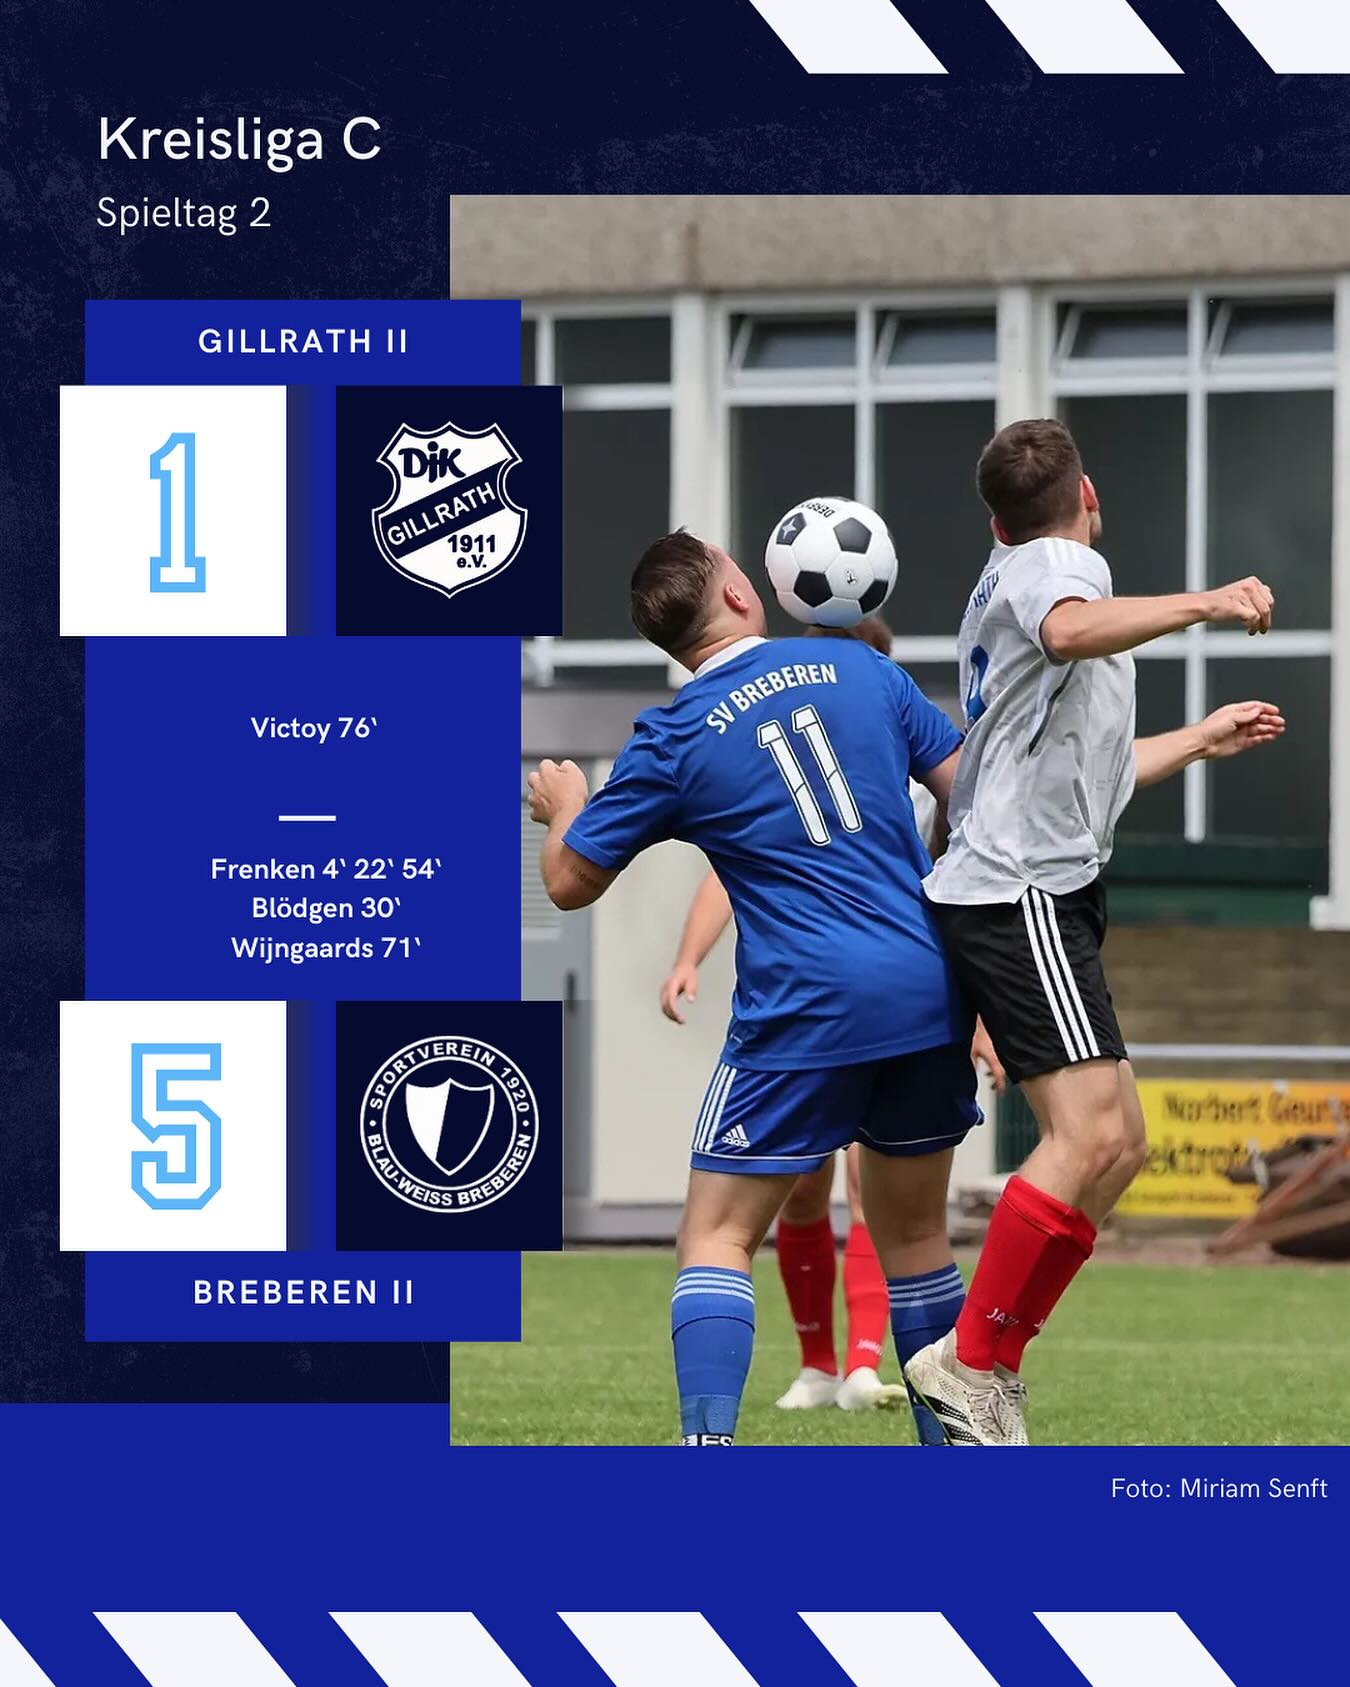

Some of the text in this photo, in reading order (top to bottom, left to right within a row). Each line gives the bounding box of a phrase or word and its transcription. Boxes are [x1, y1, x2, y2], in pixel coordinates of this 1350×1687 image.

[706, 663, 838, 735] SV BREBEREN
[757, 704, 863, 846] 11
[721, 1136, 751, 1148] adidas
